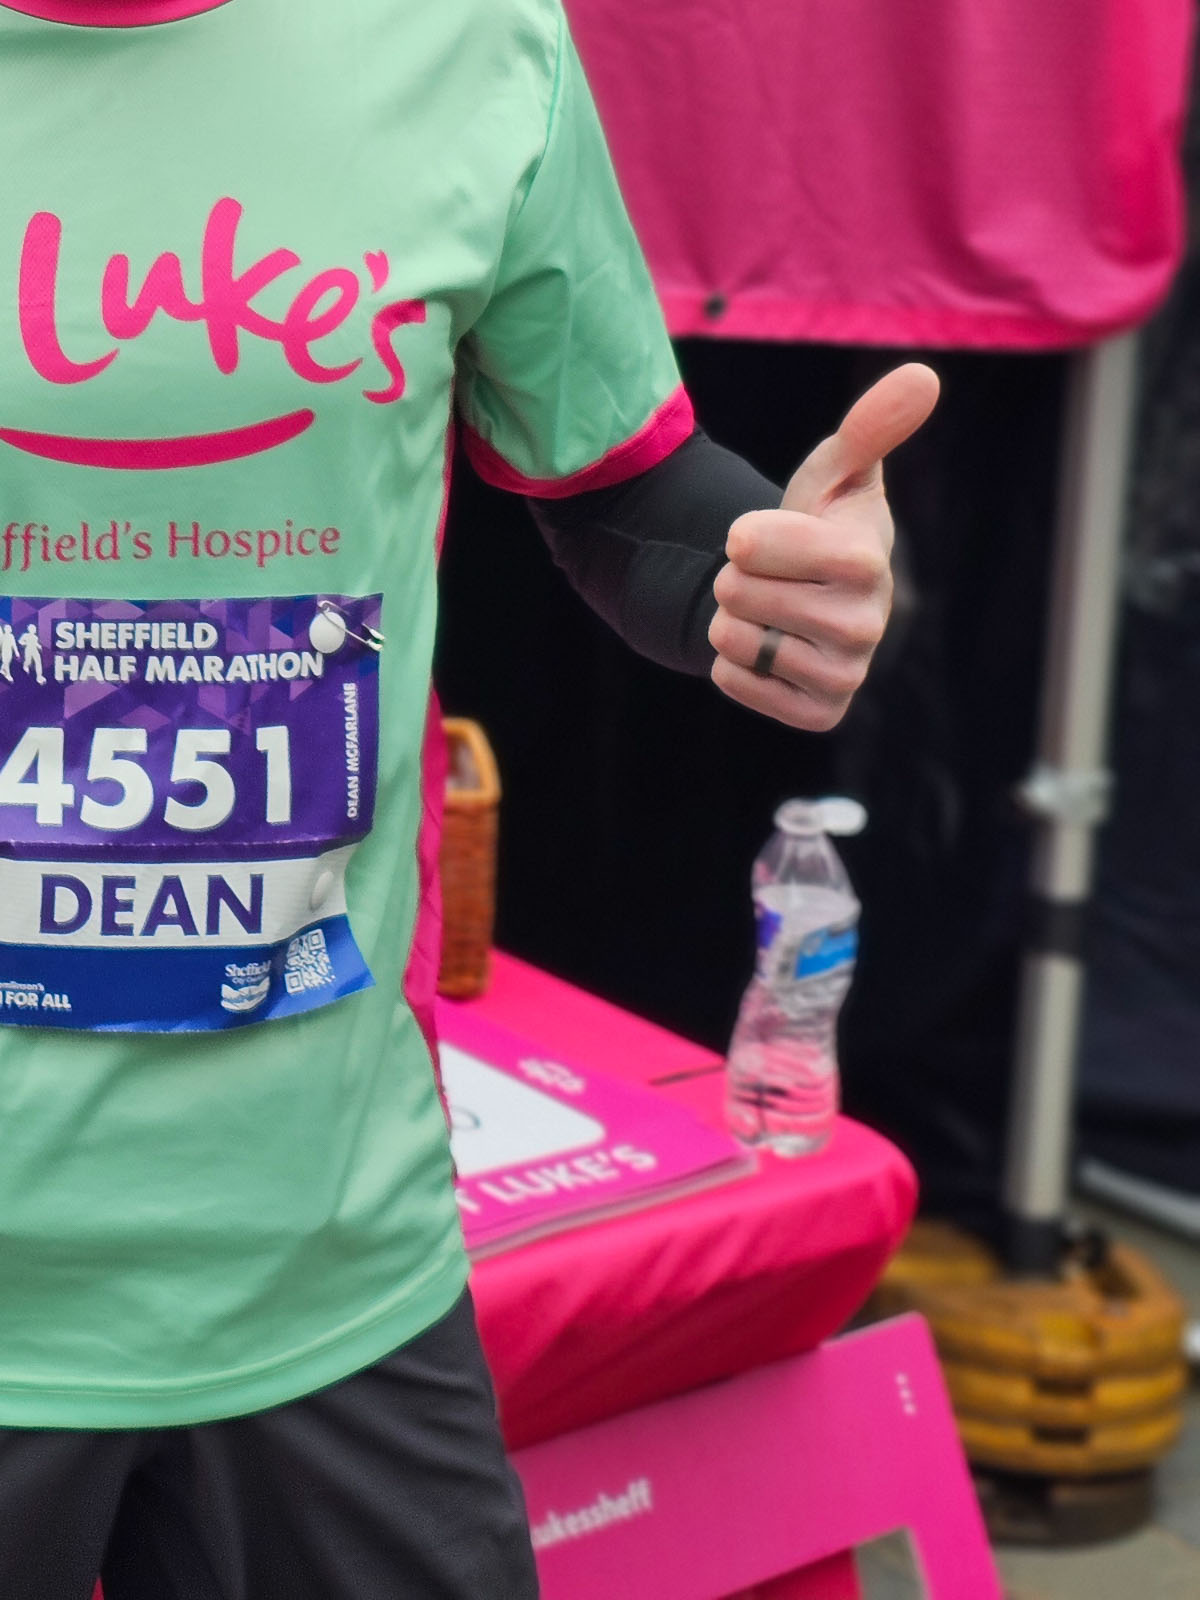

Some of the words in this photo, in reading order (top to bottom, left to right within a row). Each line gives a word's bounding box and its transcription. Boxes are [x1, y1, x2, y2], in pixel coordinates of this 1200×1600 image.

[19, 197, 426, 405] Luke's
[167, 520, 341, 568] Hospice
[55, 622, 218, 649] SHEFFIELD
[54, 655, 136, 682] HALF
[145, 651, 324, 683] MARATHON
[346, 775, 359, 818] DEAN
[39, 873, 264, 937] DEAN
[5, 990, 38, 1009] FOR
[41, 992, 72, 1011] ALL
[477, 1143, 657, 1206] LUKE'S
[530, 1477, 652, 1550] ukessheff
